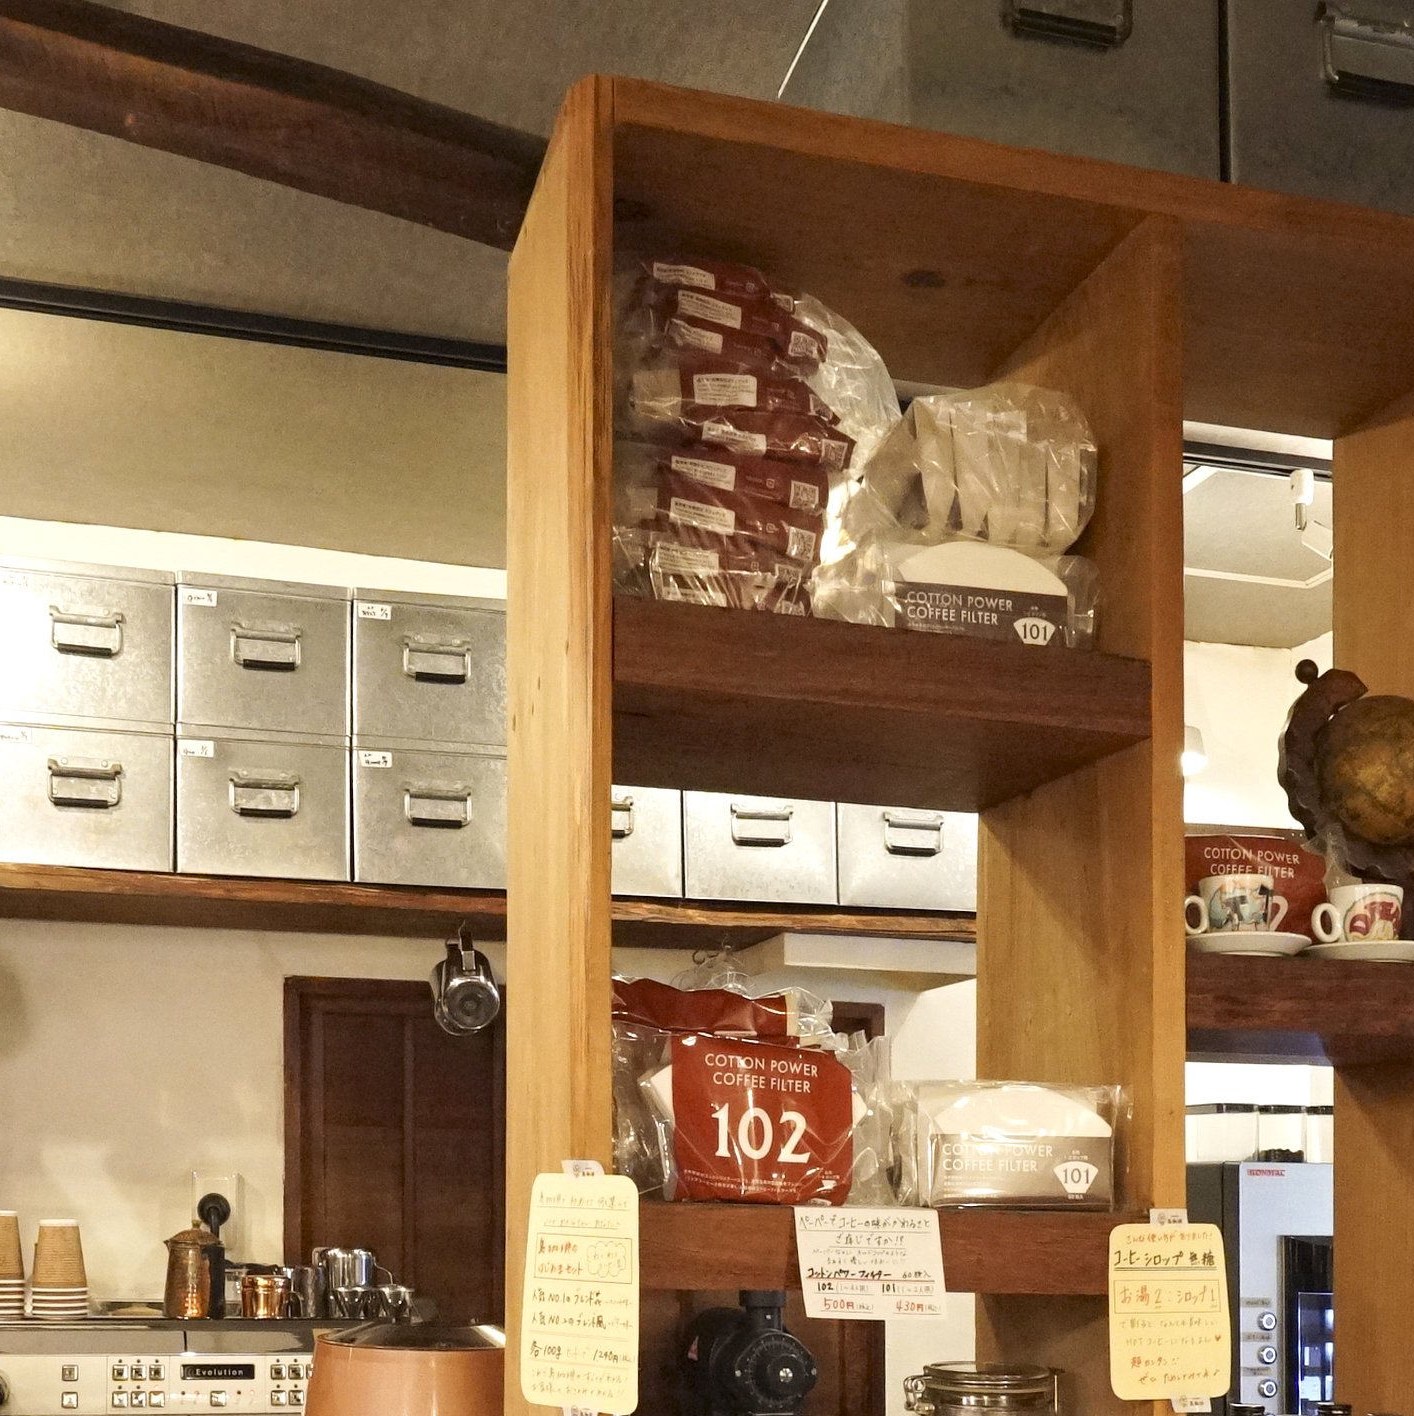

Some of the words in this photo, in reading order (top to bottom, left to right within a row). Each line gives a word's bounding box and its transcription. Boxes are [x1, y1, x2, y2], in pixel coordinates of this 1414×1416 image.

[907, 591, 963, 607] COTTON
[968, 596, 1013, 612] POWER
[907, 606, 956, 622] COFFEE
[961, 610, 998, 625] FILTER
[1022, 623, 1048, 641] 101
[1204, 847, 1252, 861] COTTON
[1258, 851, 1300, 865] POWER
[1258, 865, 1295, 879] FILTER
[705, 1053, 765, 1071] COTTON
[771, 1060, 818, 1078] POWER
[713, 1072, 765, 1089] COFFEE
[771, 1077, 811, 1093] FILTER
[711, 1102, 811, 1164] 102
[943, 1159, 993, 1171] COFFEE
[999, 1160, 1038, 1172] FILTER
[1063, 1168, 1089, 1184] 101
[817, 1282, 834, 1291] 102
[882, 1283, 896, 1294] 101
[823, 1297, 855, 1311] 500円
[895, 1300, 924, 1312] 430円
[196, 1368, 244, 1376] Evolution
